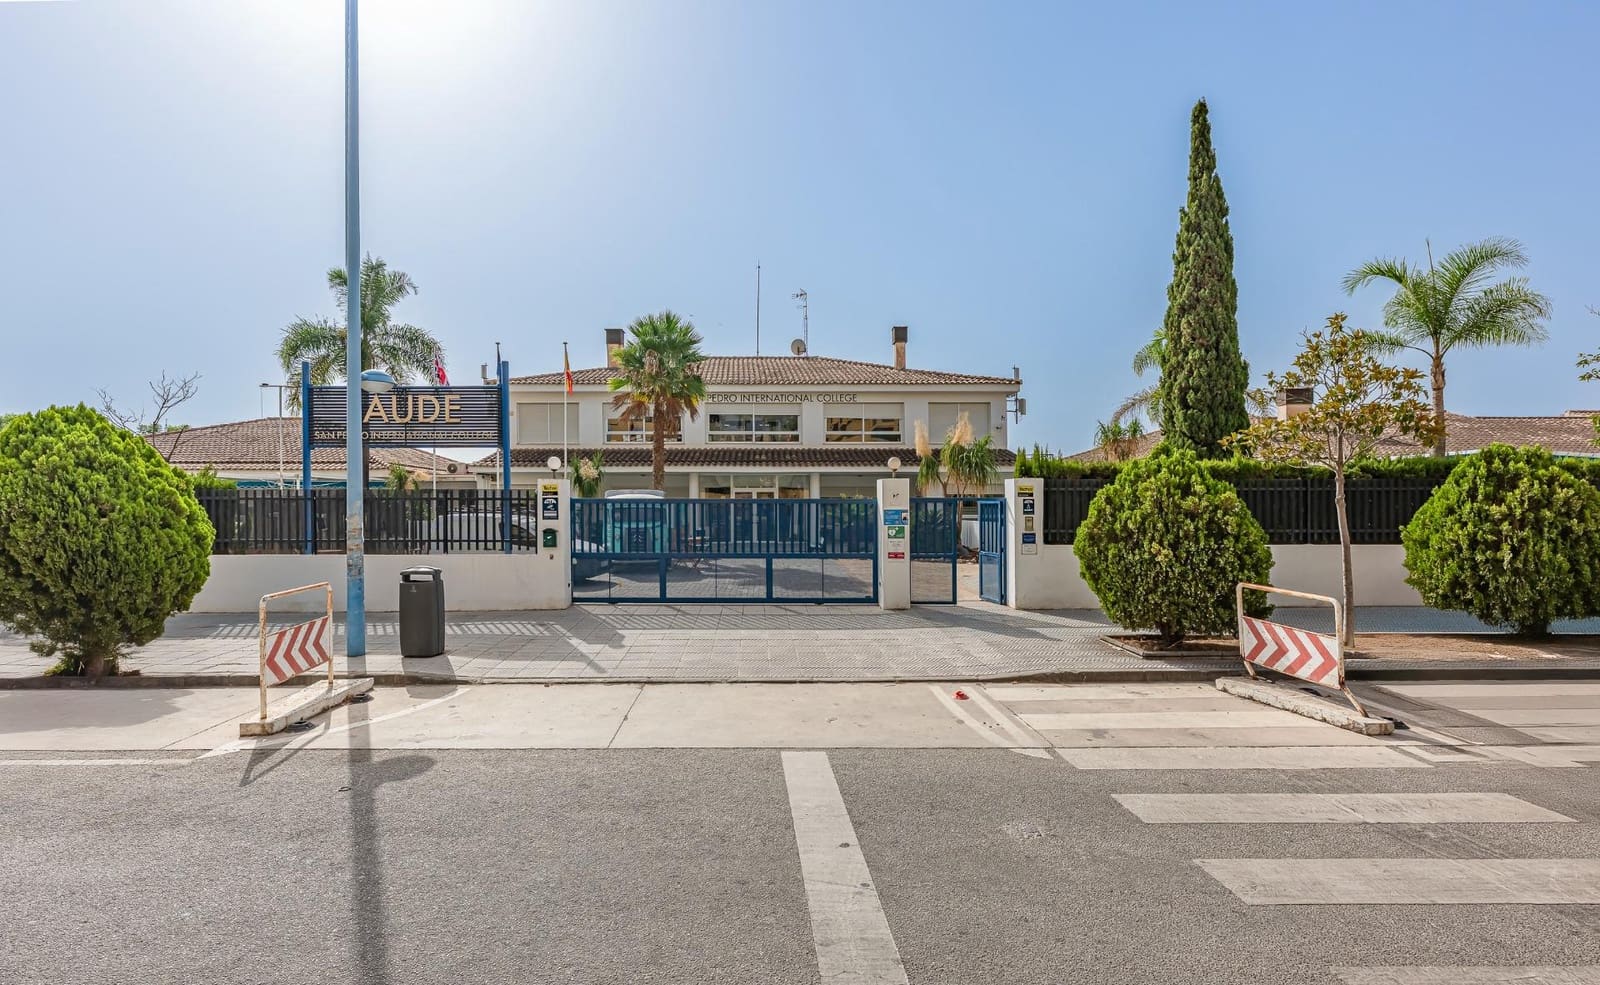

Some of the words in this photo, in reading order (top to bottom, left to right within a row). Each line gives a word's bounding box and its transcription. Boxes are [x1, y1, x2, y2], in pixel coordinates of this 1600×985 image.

[707, 393, 737, 403] PEDRO
[740, 393, 813, 403] INTERNATIONAL
[818, 393, 857, 403] COLLEGE
[314, 431, 336, 440] SAN
[337, 431, 369, 440] PEO
